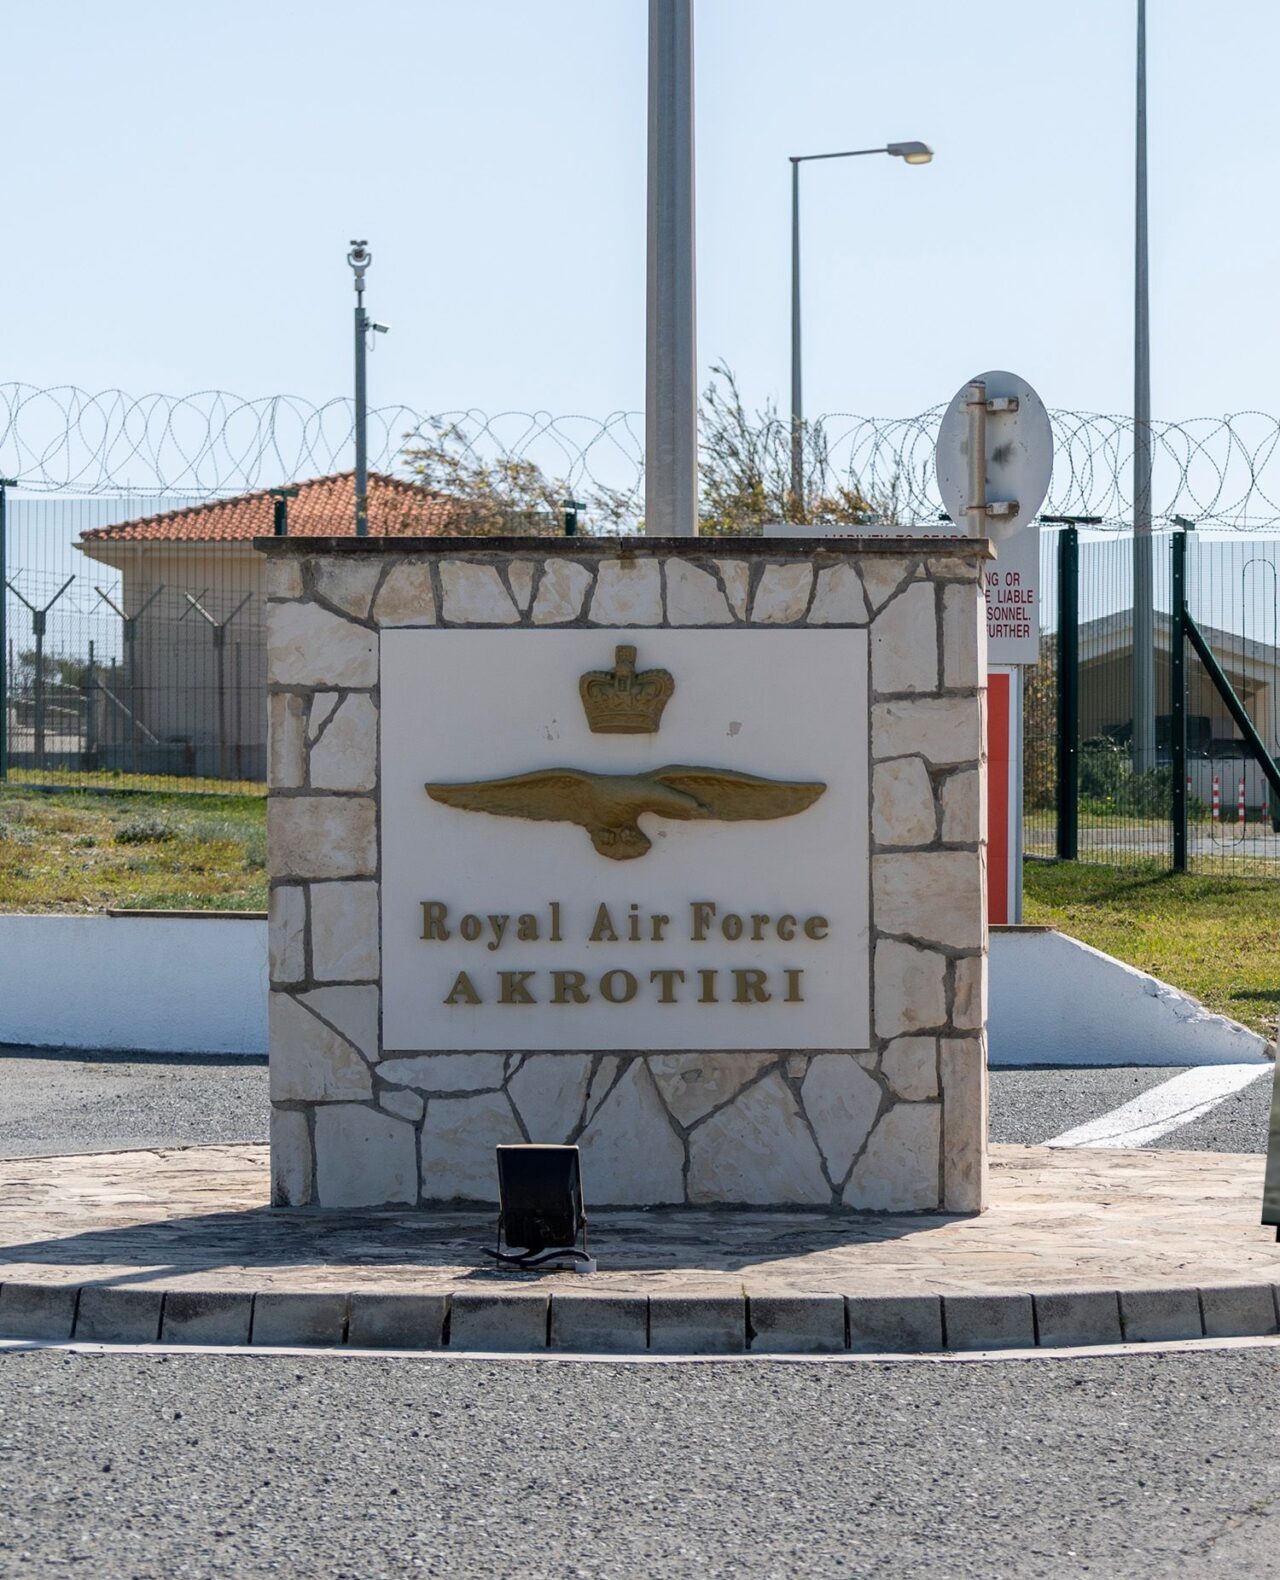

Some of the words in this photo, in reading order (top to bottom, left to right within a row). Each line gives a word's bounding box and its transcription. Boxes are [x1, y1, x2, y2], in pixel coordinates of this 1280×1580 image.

[1005, 572, 1020, 586] OR
[998, 589, 1033, 604] LIABLE
[986, 606, 1031, 621] SONNEL.
[986, 624, 1030, 638] URTHER
[419, 901, 564, 951] Royal
[588, 902, 670, 943] Air
[689, 901, 831, 942] Force
[443, 969, 805, 1005] AKROTIRI
